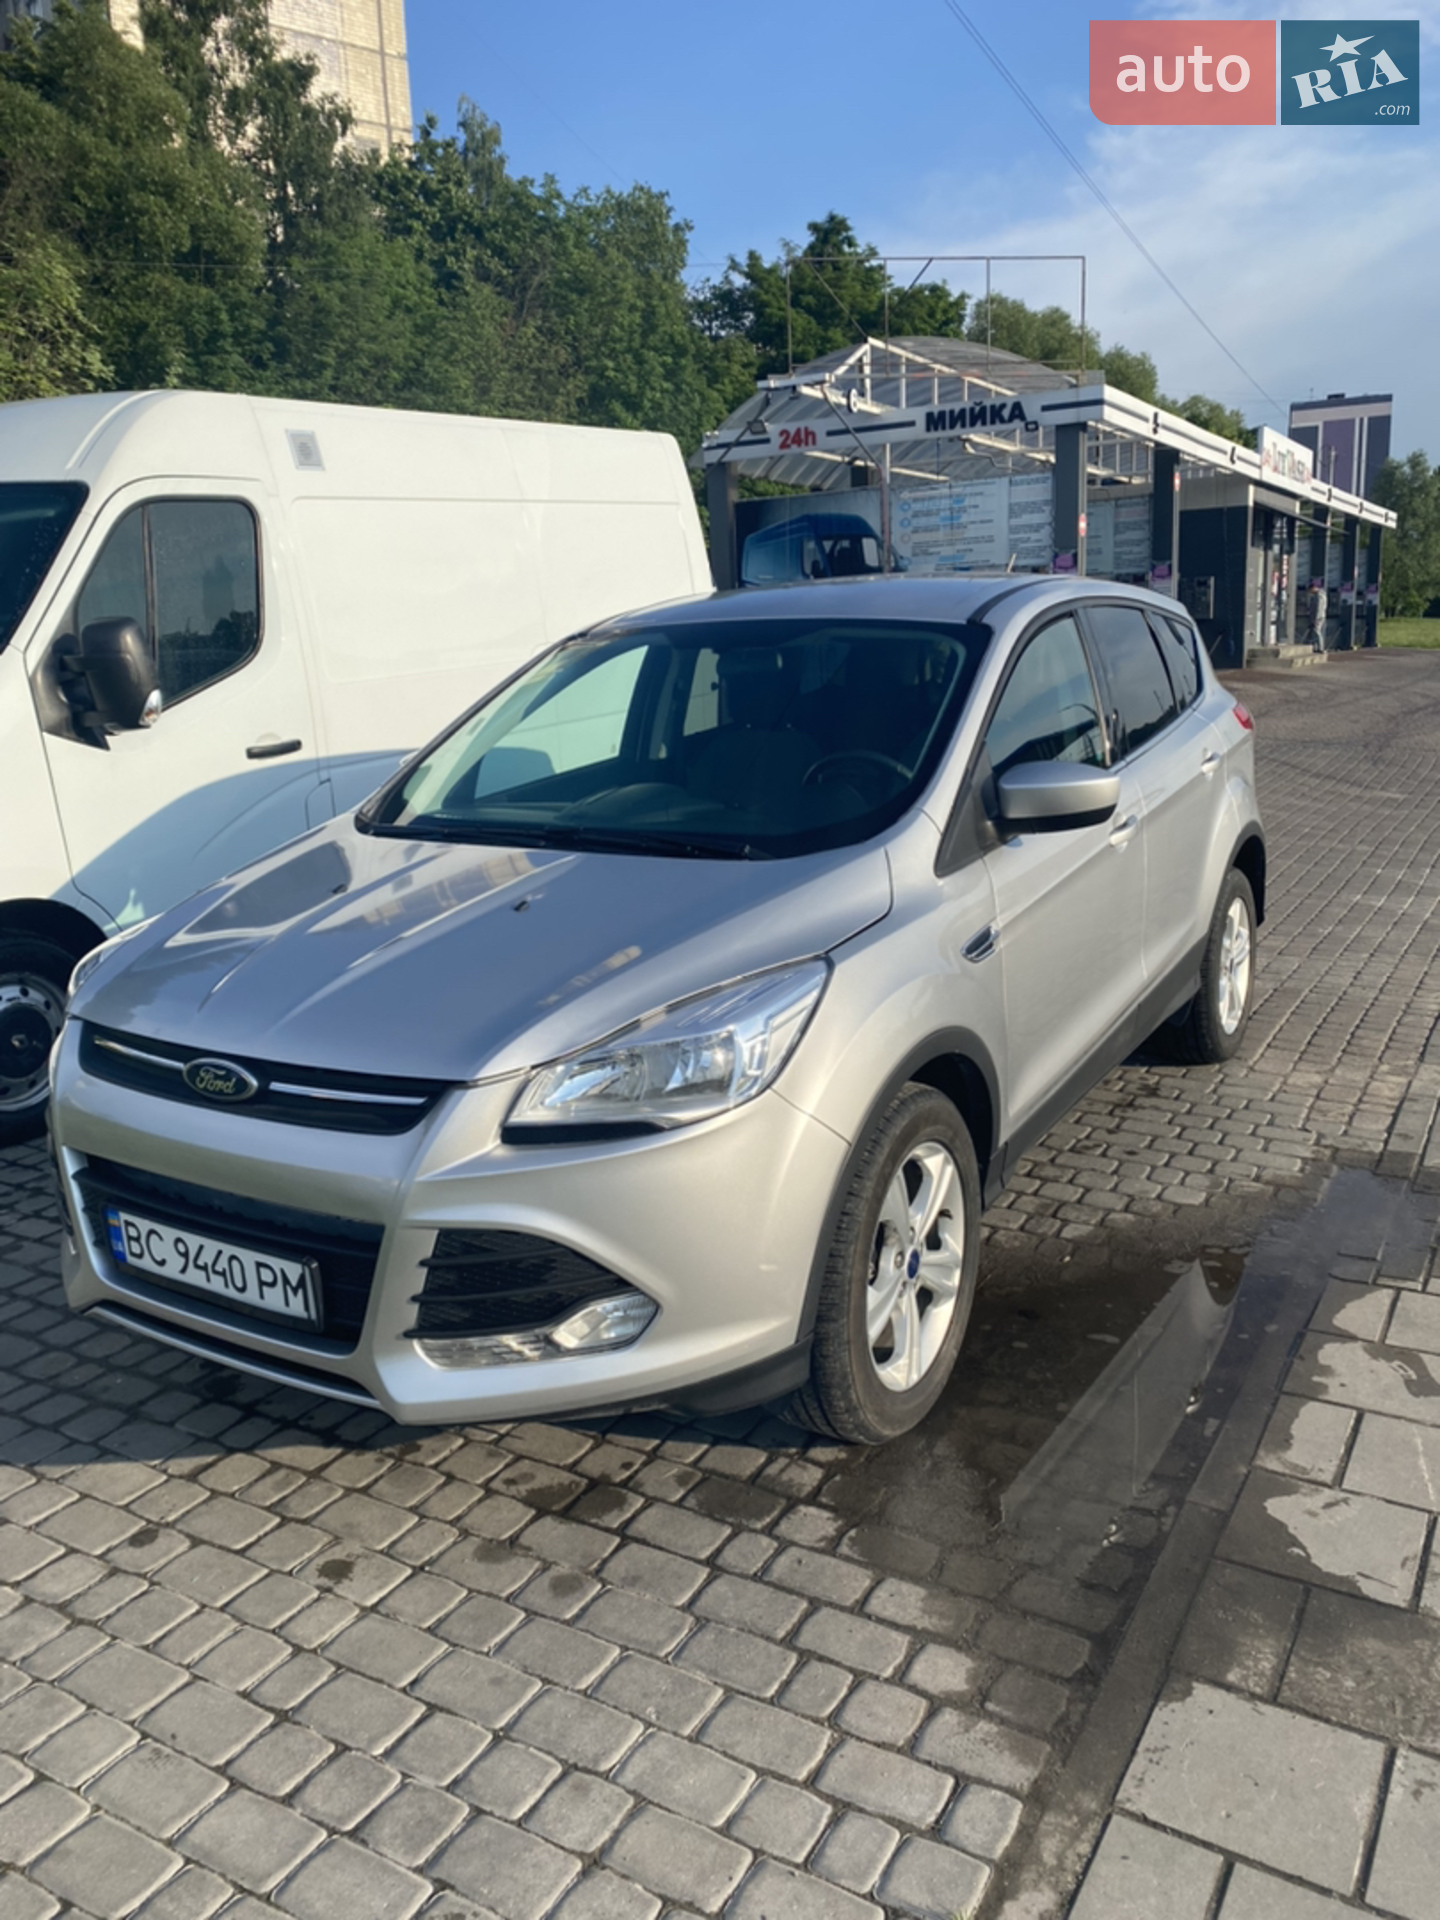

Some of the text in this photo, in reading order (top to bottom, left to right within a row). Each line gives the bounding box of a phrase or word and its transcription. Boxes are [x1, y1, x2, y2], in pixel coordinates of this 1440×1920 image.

[925, 401, 1027, 433] МИЙКА
[778, 426, 817, 450] 24h
[195, 1066, 237, 1095] Ford
[123, 1219, 167, 1268] BC
[173, 1236, 248, 1294] 9440
